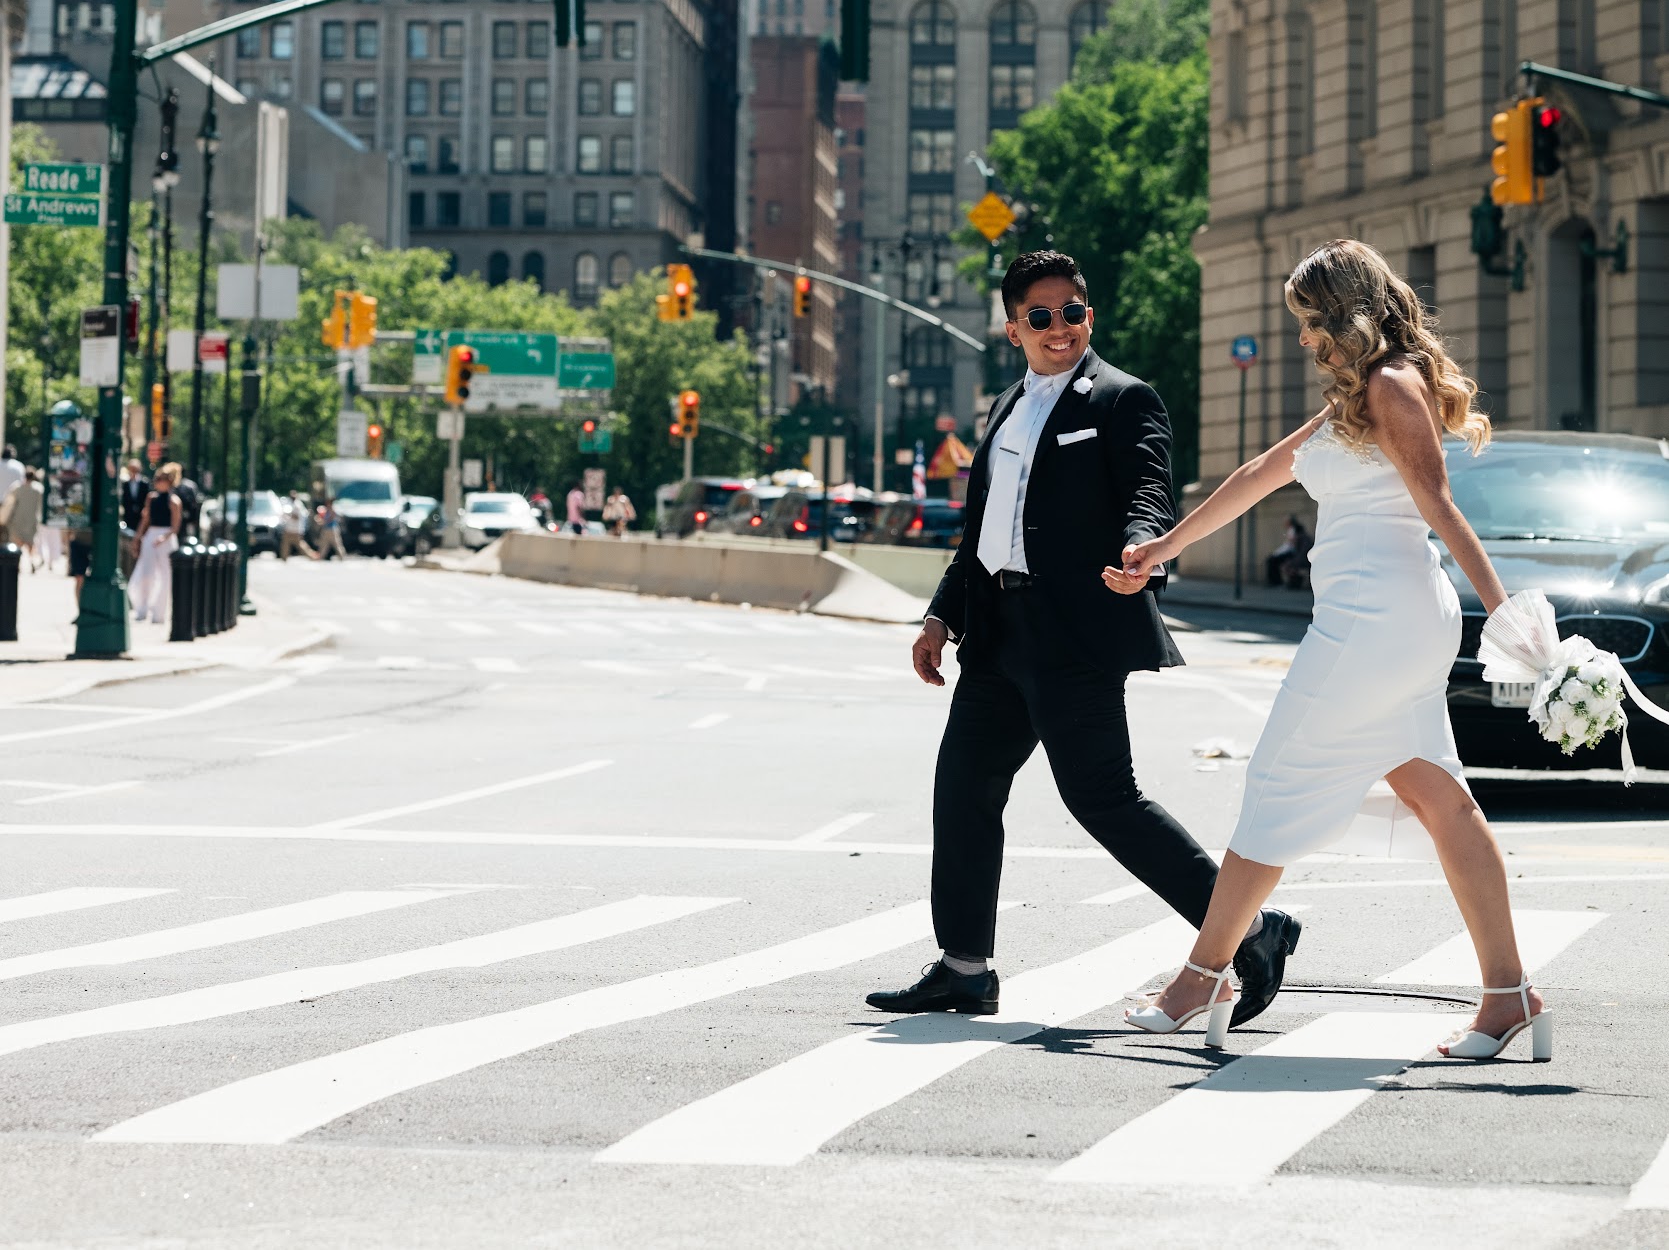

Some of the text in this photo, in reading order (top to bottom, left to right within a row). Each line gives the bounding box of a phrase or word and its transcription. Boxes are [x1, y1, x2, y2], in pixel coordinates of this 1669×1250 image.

[28, 166, 79, 191] Reade
[6, 196, 97, 216] St Andrews
